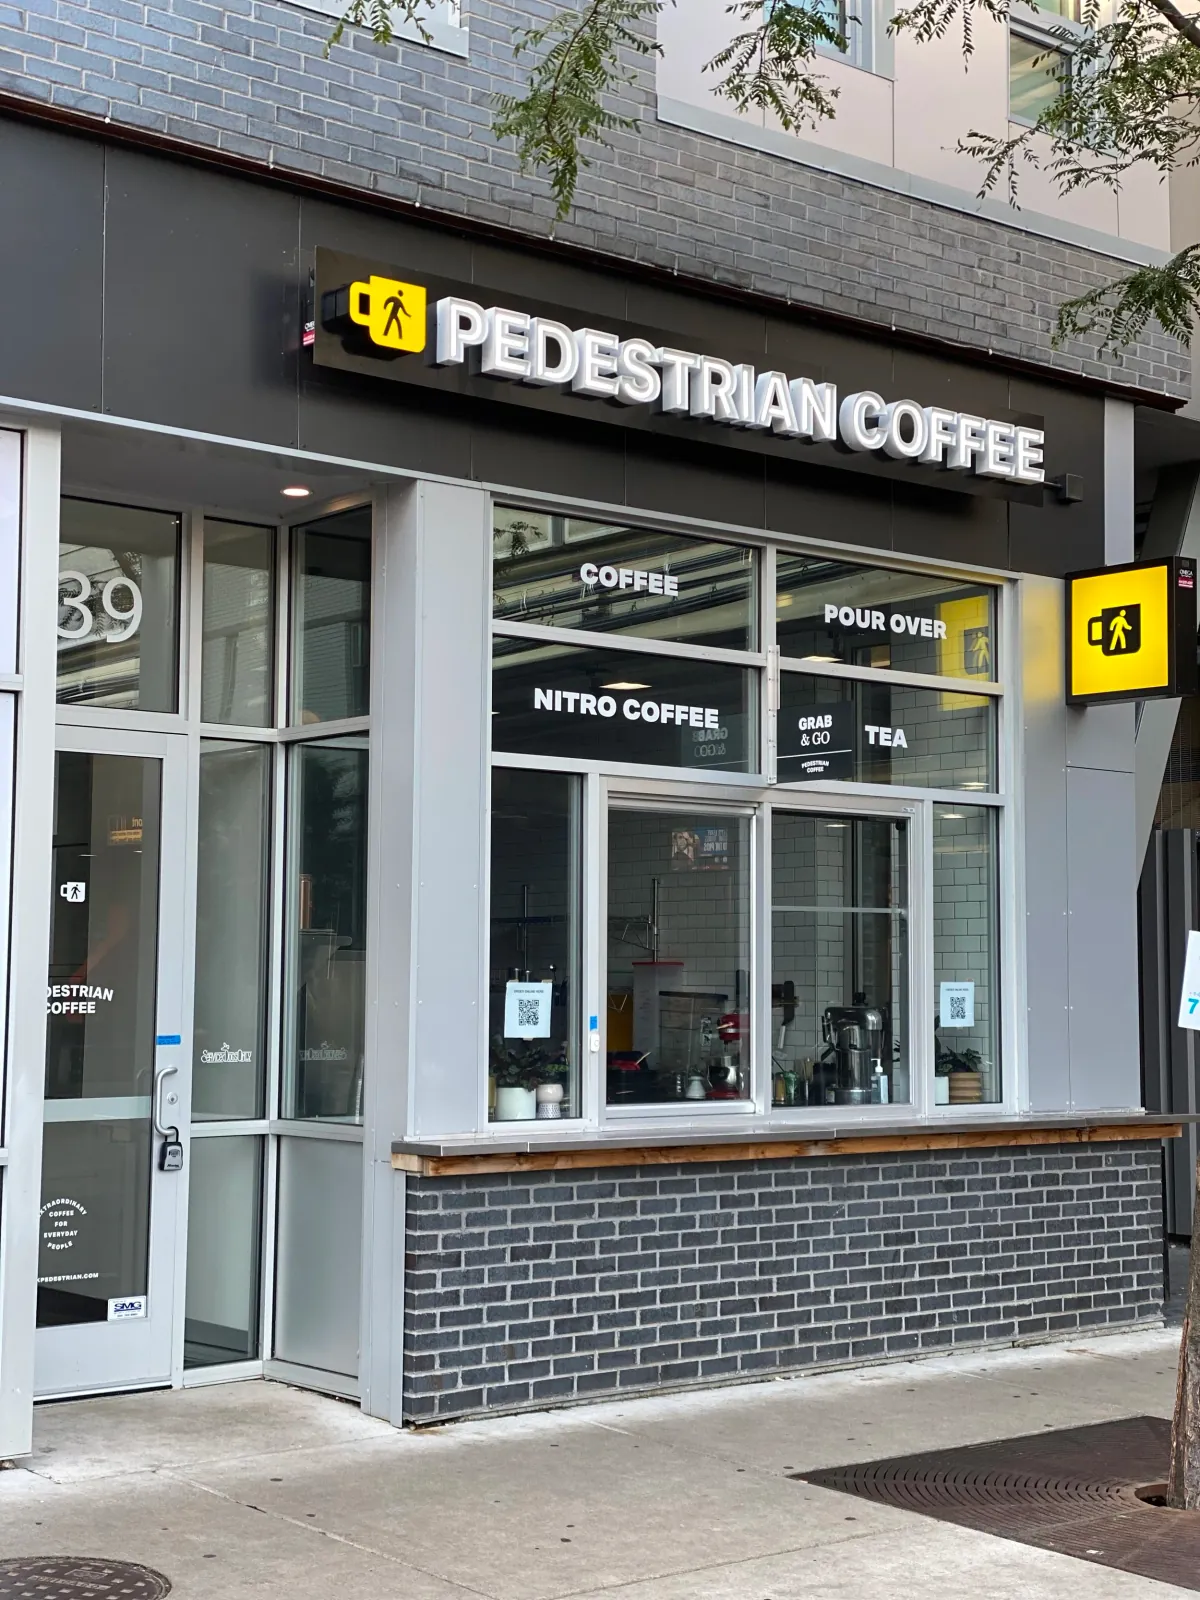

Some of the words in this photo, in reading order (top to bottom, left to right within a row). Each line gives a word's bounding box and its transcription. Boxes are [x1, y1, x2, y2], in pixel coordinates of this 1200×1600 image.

[436, 296, 836, 442] PEDESTRIAN
[839, 391, 1045, 485] COFFEE
[580, 562, 679, 597] COFFEE
[57, 570, 143, 643] 39
[824, 603, 886, 631] POUR
[890, 613, 947, 640] OVER
[534, 687, 617, 718] NITRO
[622, 699, 719, 730] COFFEE
[798, 714, 833, 731] GRAB
[800, 733, 810, 747] &
[812, 731, 830, 745] GO
[864, 725, 908, 749] TEA
[801, 760, 830, 769] PEDESTRIAN
[1188, 998, 1199, 1014] 7
[48, 1209, 75, 1218] COFFEE
[54, 1220, 68, 1228] FOR
[43, 1230, 78, 1239] EVERYDAY
[46, 1240, 73, 1250] PEOPLE
[114, 1301, 142, 1310] SMG
